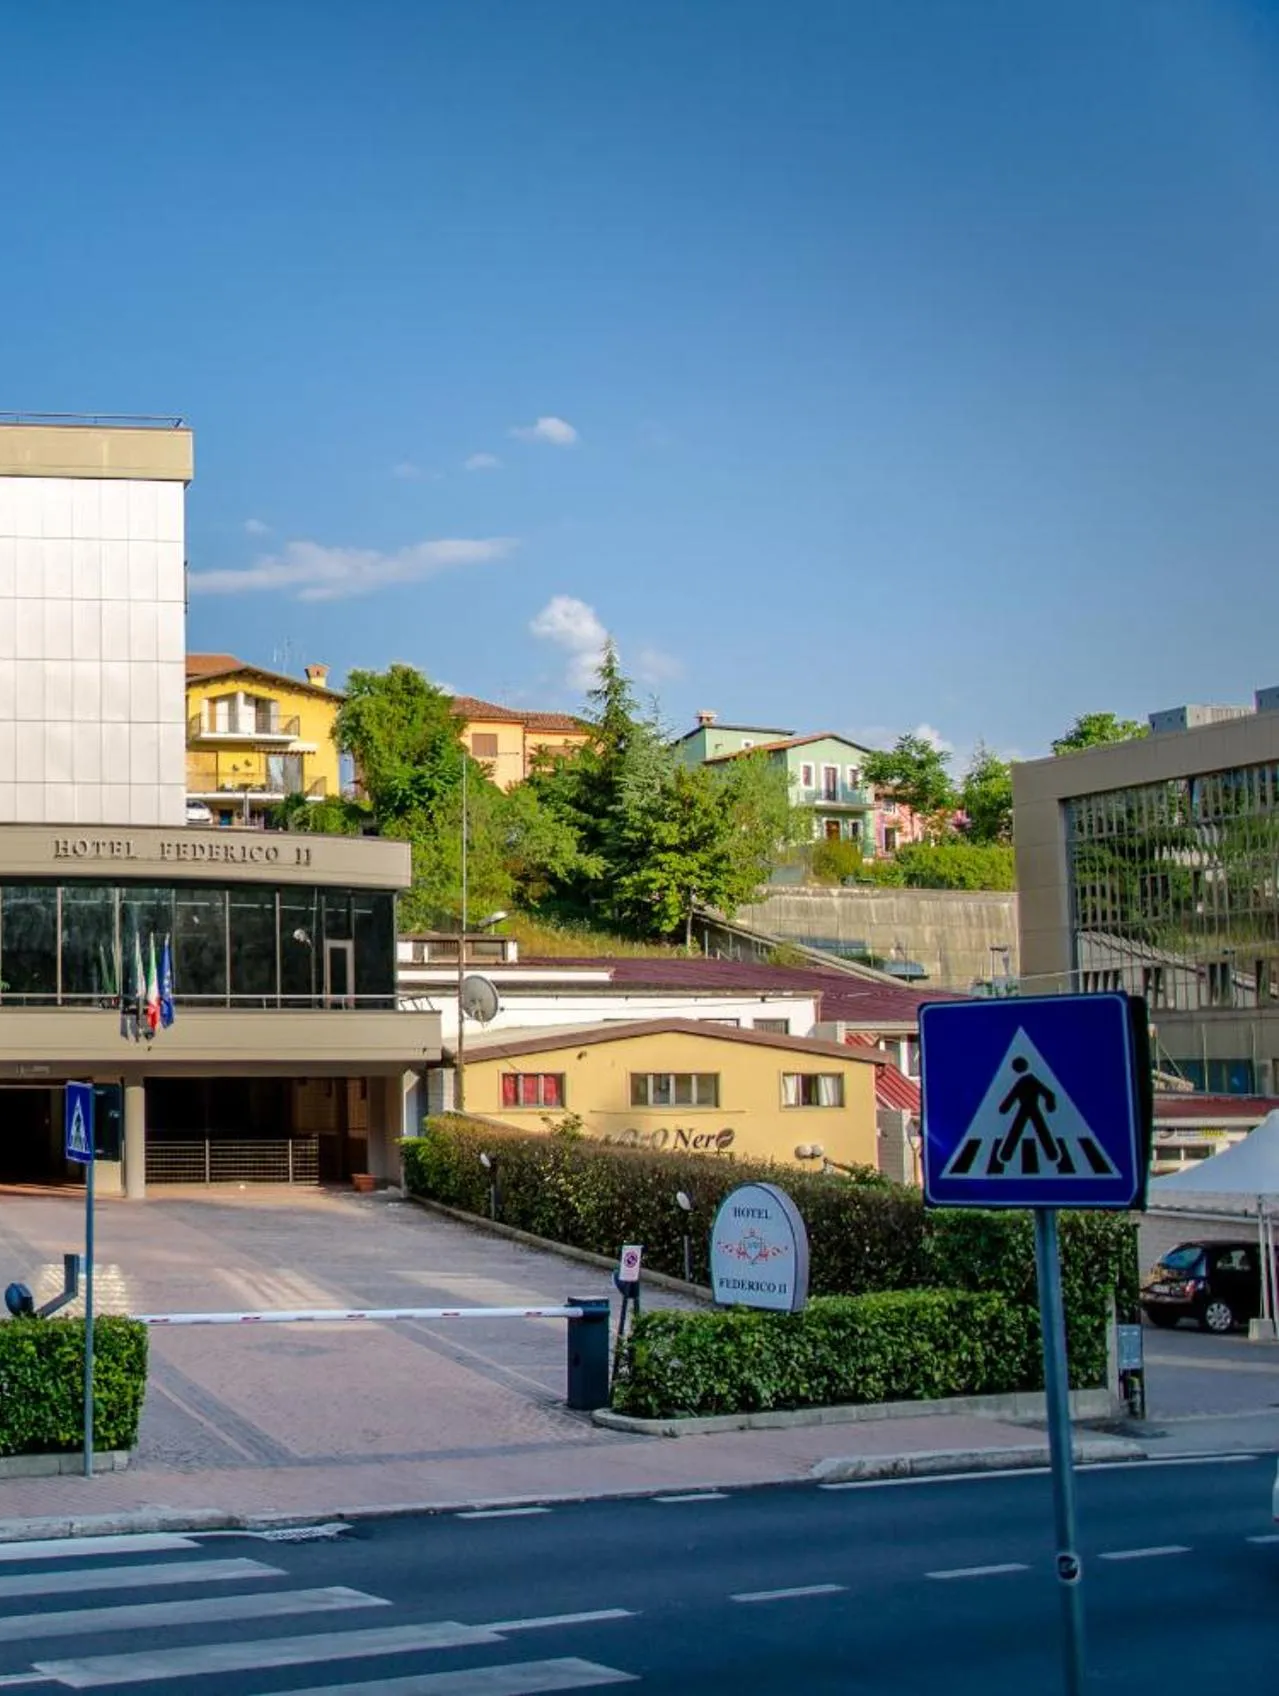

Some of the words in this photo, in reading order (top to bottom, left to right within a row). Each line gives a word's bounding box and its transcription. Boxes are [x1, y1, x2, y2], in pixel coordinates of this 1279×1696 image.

[53, 840, 137, 860] HOTEL
[160, 842, 279, 863] FEDERICO
[295, 847, 312, 866] II
[733, 1207, 771, 1219] HOTEL
[719, 1278, 776, 1293] FEDERICO
[777, 1283, 787, 1294] II
